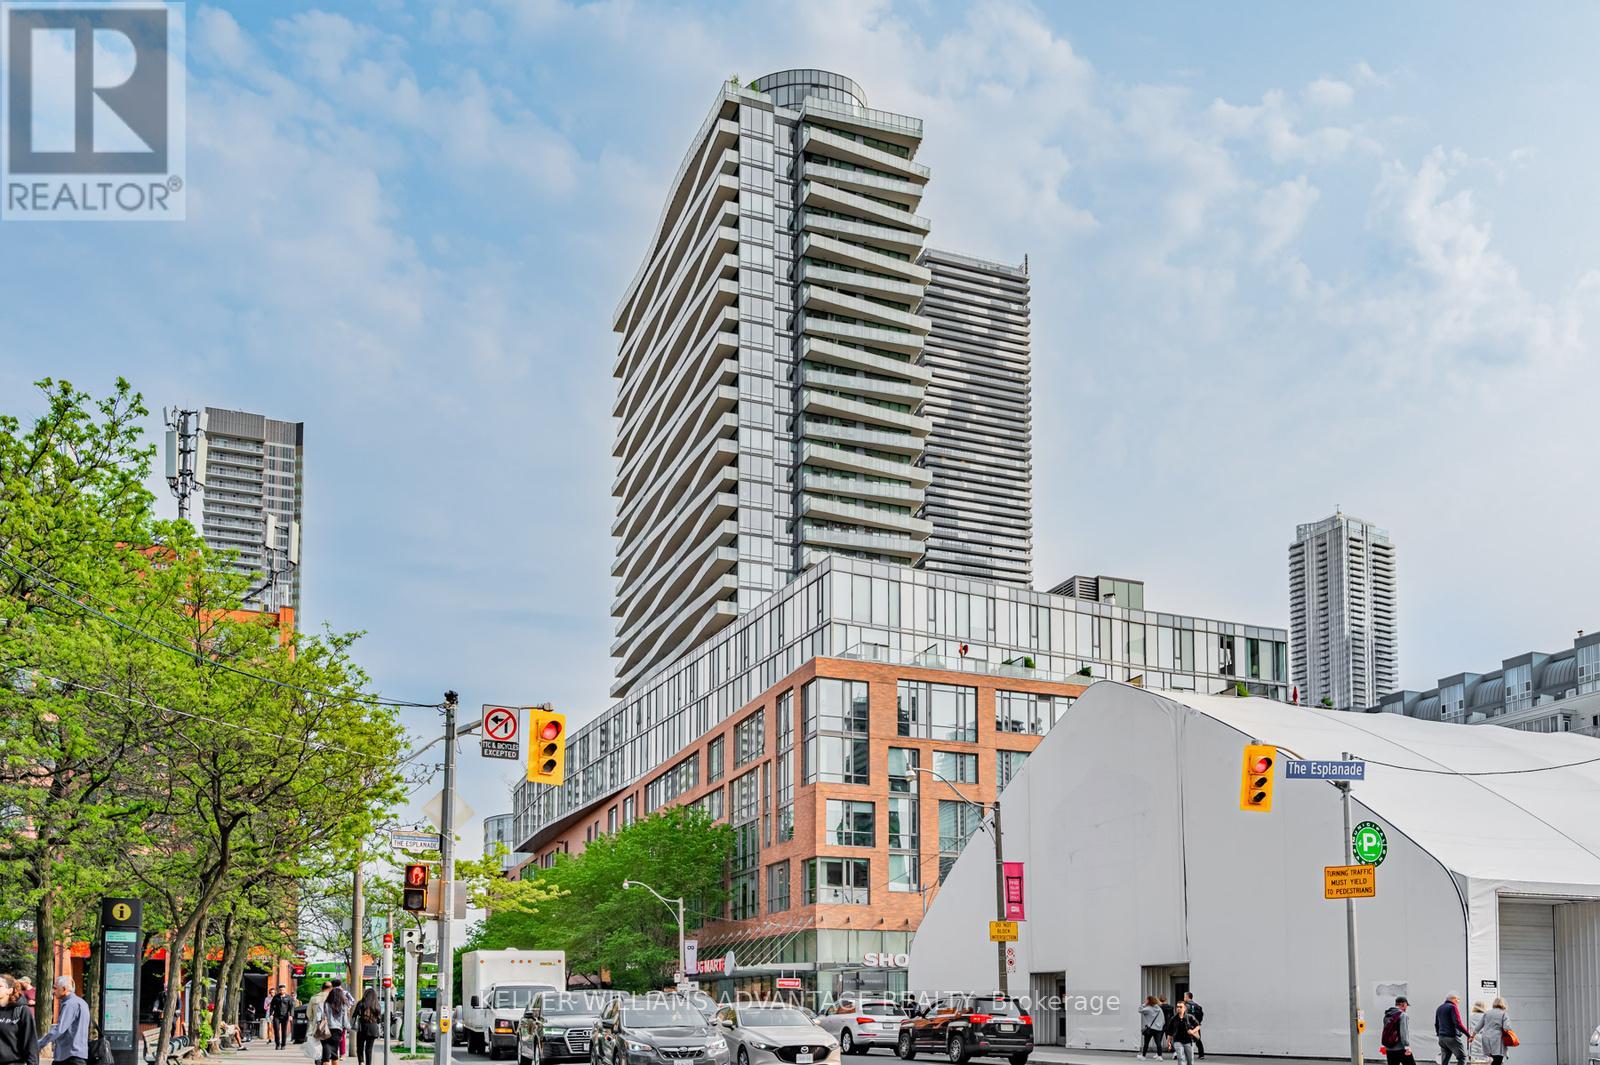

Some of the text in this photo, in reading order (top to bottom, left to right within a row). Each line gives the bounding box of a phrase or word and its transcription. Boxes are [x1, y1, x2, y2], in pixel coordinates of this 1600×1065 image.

[497, 742, 519, 751] BICYCLES
[484, 749, 517, 758] EXCEPTED
[1288, 762, 1363, 778] The Esplanade
[1352, 822, 1387, 844] MUNICIPAL
[406, 840, 438, 848] ESPLANADE
[1362, 832, 1377, 852] P
[1350, 868, 1372, 876] TRAFFIC
[1336, 887, 1372, 895] PEDESTRIANS
[863, 952, 909, 968] SHO
